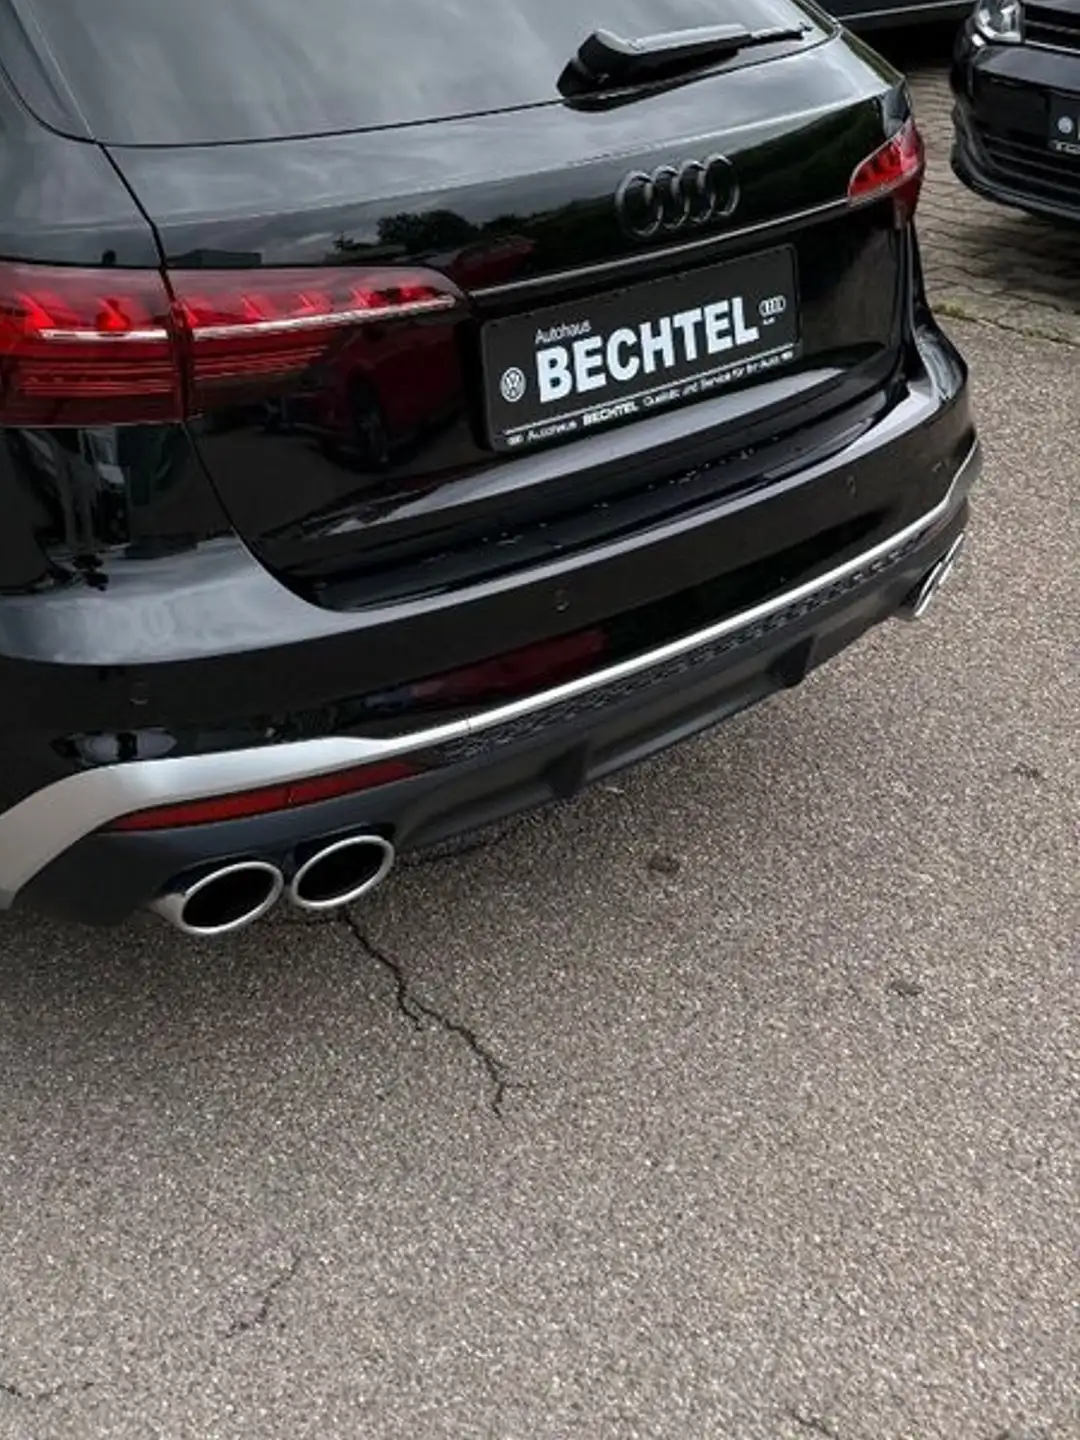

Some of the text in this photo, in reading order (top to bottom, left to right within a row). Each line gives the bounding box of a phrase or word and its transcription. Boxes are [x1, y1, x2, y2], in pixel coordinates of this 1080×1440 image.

[535, 320, 592, 344] Autohaus
[535, 297, 759, 403] BECHTEL
[582, 401, 639, 426] BECHTEL
